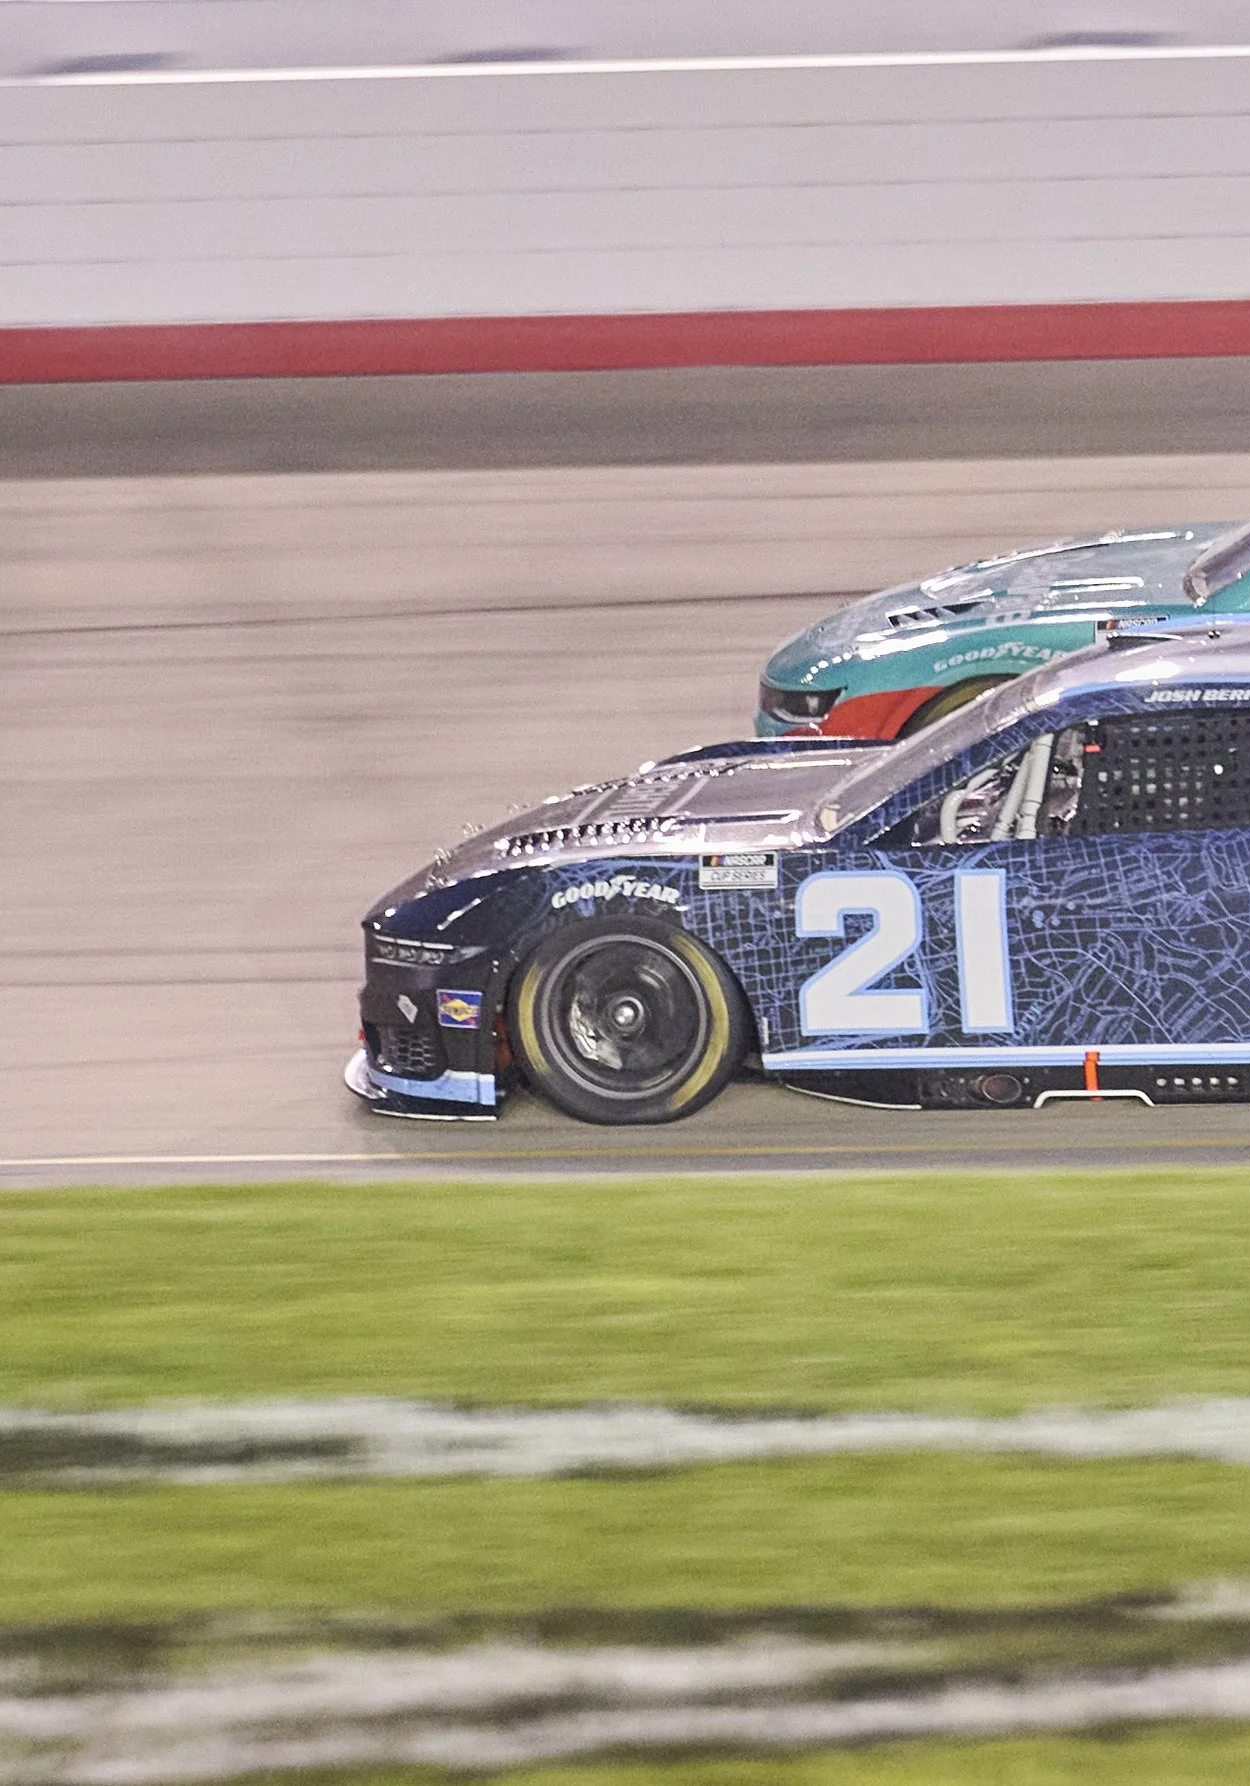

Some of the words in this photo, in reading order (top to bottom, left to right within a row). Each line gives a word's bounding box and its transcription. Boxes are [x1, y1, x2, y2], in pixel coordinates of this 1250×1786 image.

[1144, 689, 1202, 703] JOSH
[551, 874, 681, 909] GOODYEAR
[795, 868, 1014, 1036] 21
